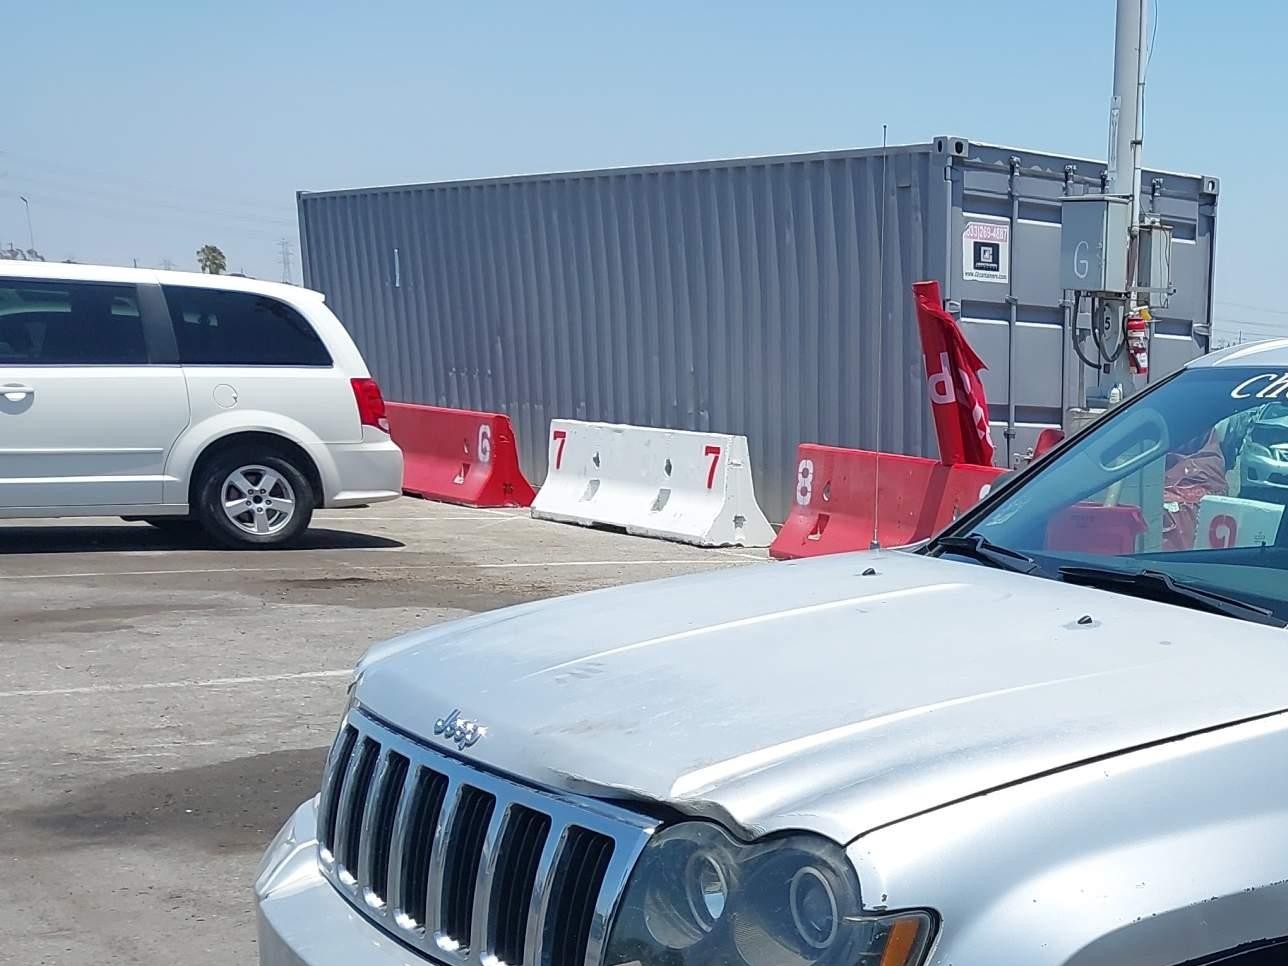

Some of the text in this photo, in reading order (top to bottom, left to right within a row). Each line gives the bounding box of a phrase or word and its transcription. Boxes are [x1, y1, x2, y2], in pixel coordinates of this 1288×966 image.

[1074, 240, 1089, 279] G
[1103, 316, 1111, 331] 5
[477, 423, 492, 463] 6
[552, 430, 567, 471] 7
[704, 446, 721, 490] 7
[796, 459, 814, 507] 8
[433, 708, 488, 751] Jeep
